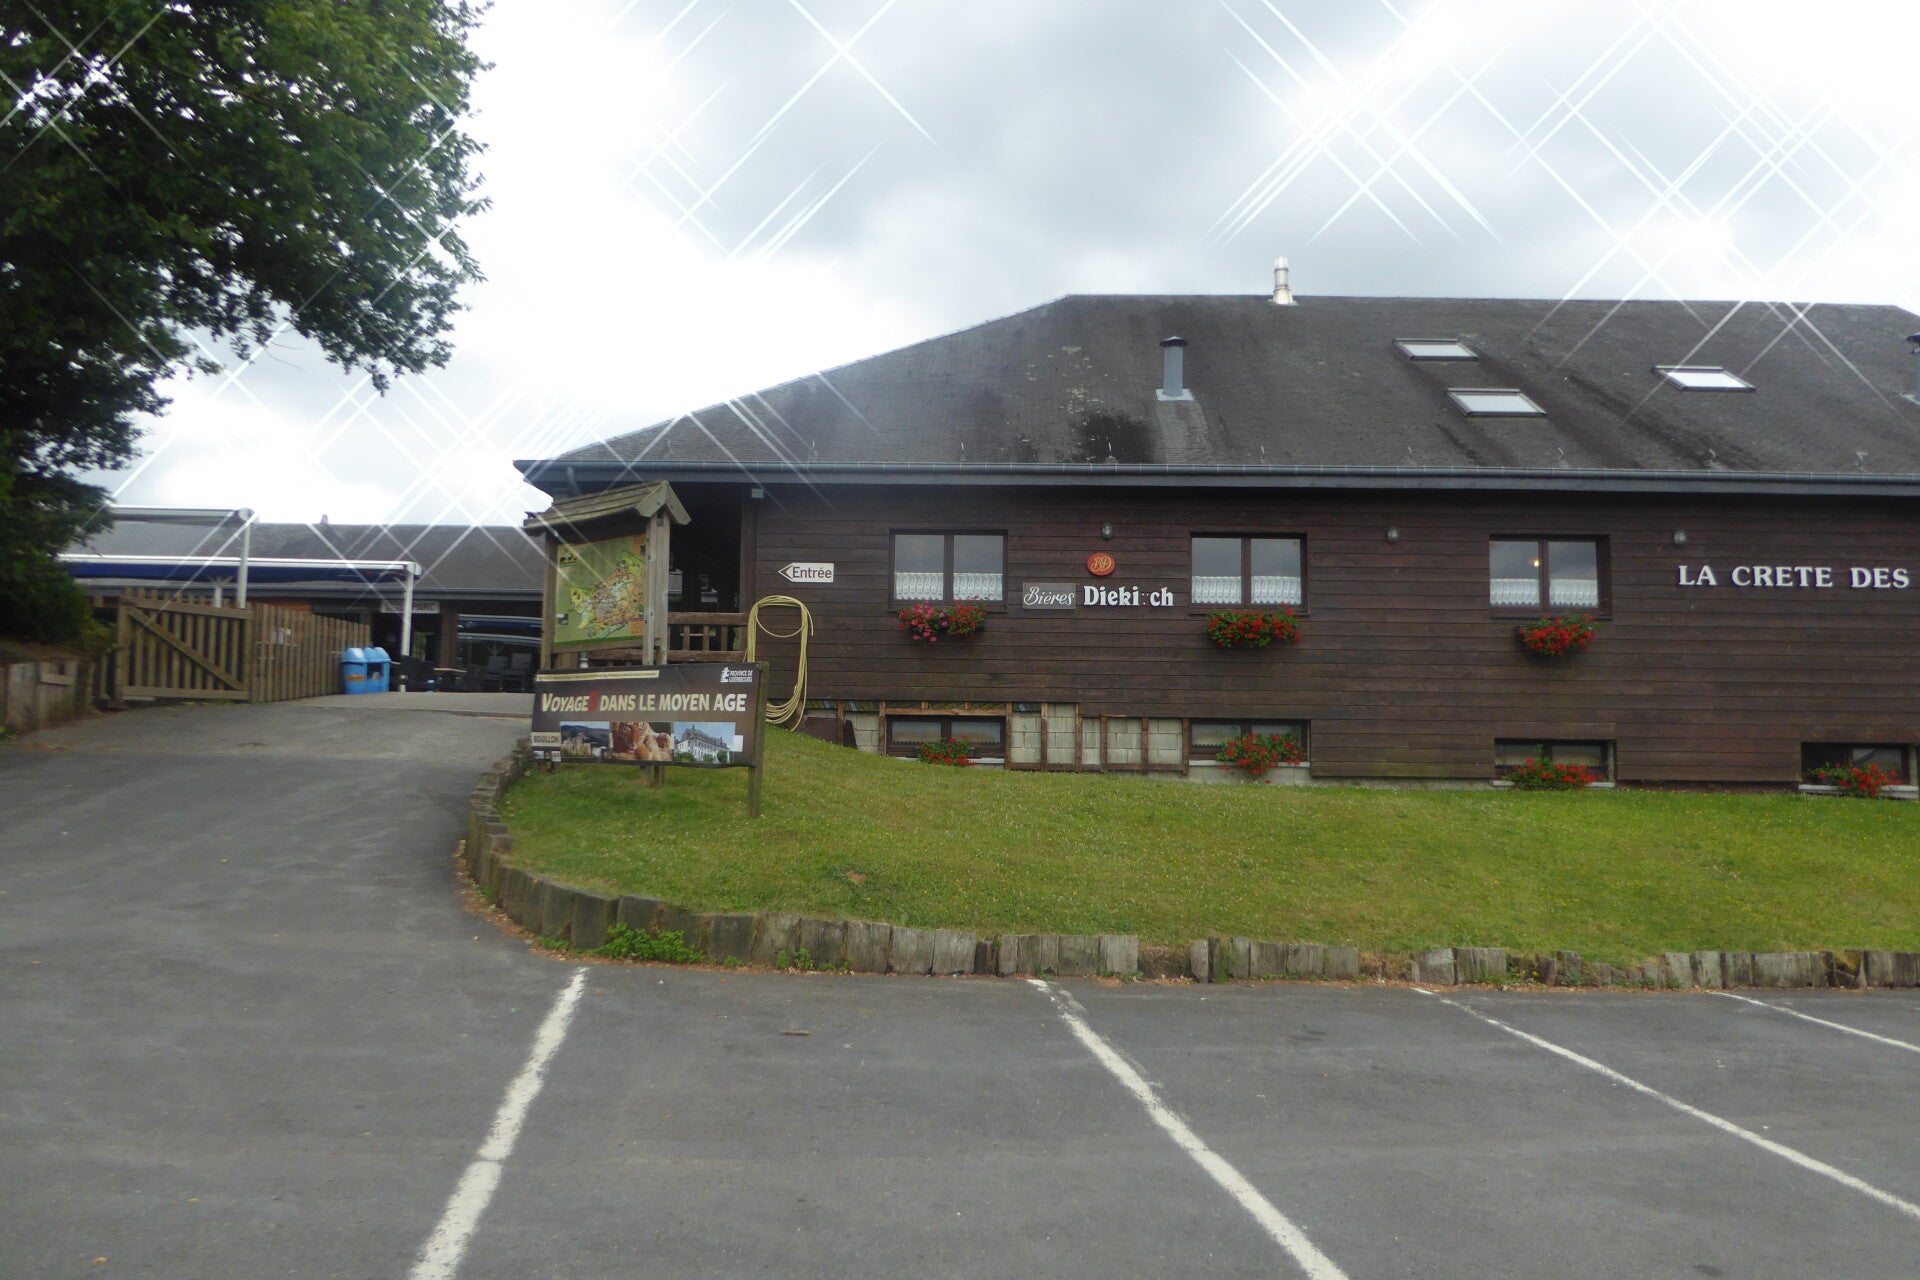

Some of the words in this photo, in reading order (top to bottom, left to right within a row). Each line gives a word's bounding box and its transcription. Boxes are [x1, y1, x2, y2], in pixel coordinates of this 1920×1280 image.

[792, 566, 832, 579] Entrée
[1678, 565, 1718, 586] LA
[1731, 565, 1833, 588] CRETE
[1850, 567, 1910, 589] DES
[1023, 586, 1075, 606] Bières
[600, 694, 636, 712] DANS
[639, 694, 656, 711] LE
[659, 694, 710, 711] MOYEN
[714, 694, 747, 711] AGE
